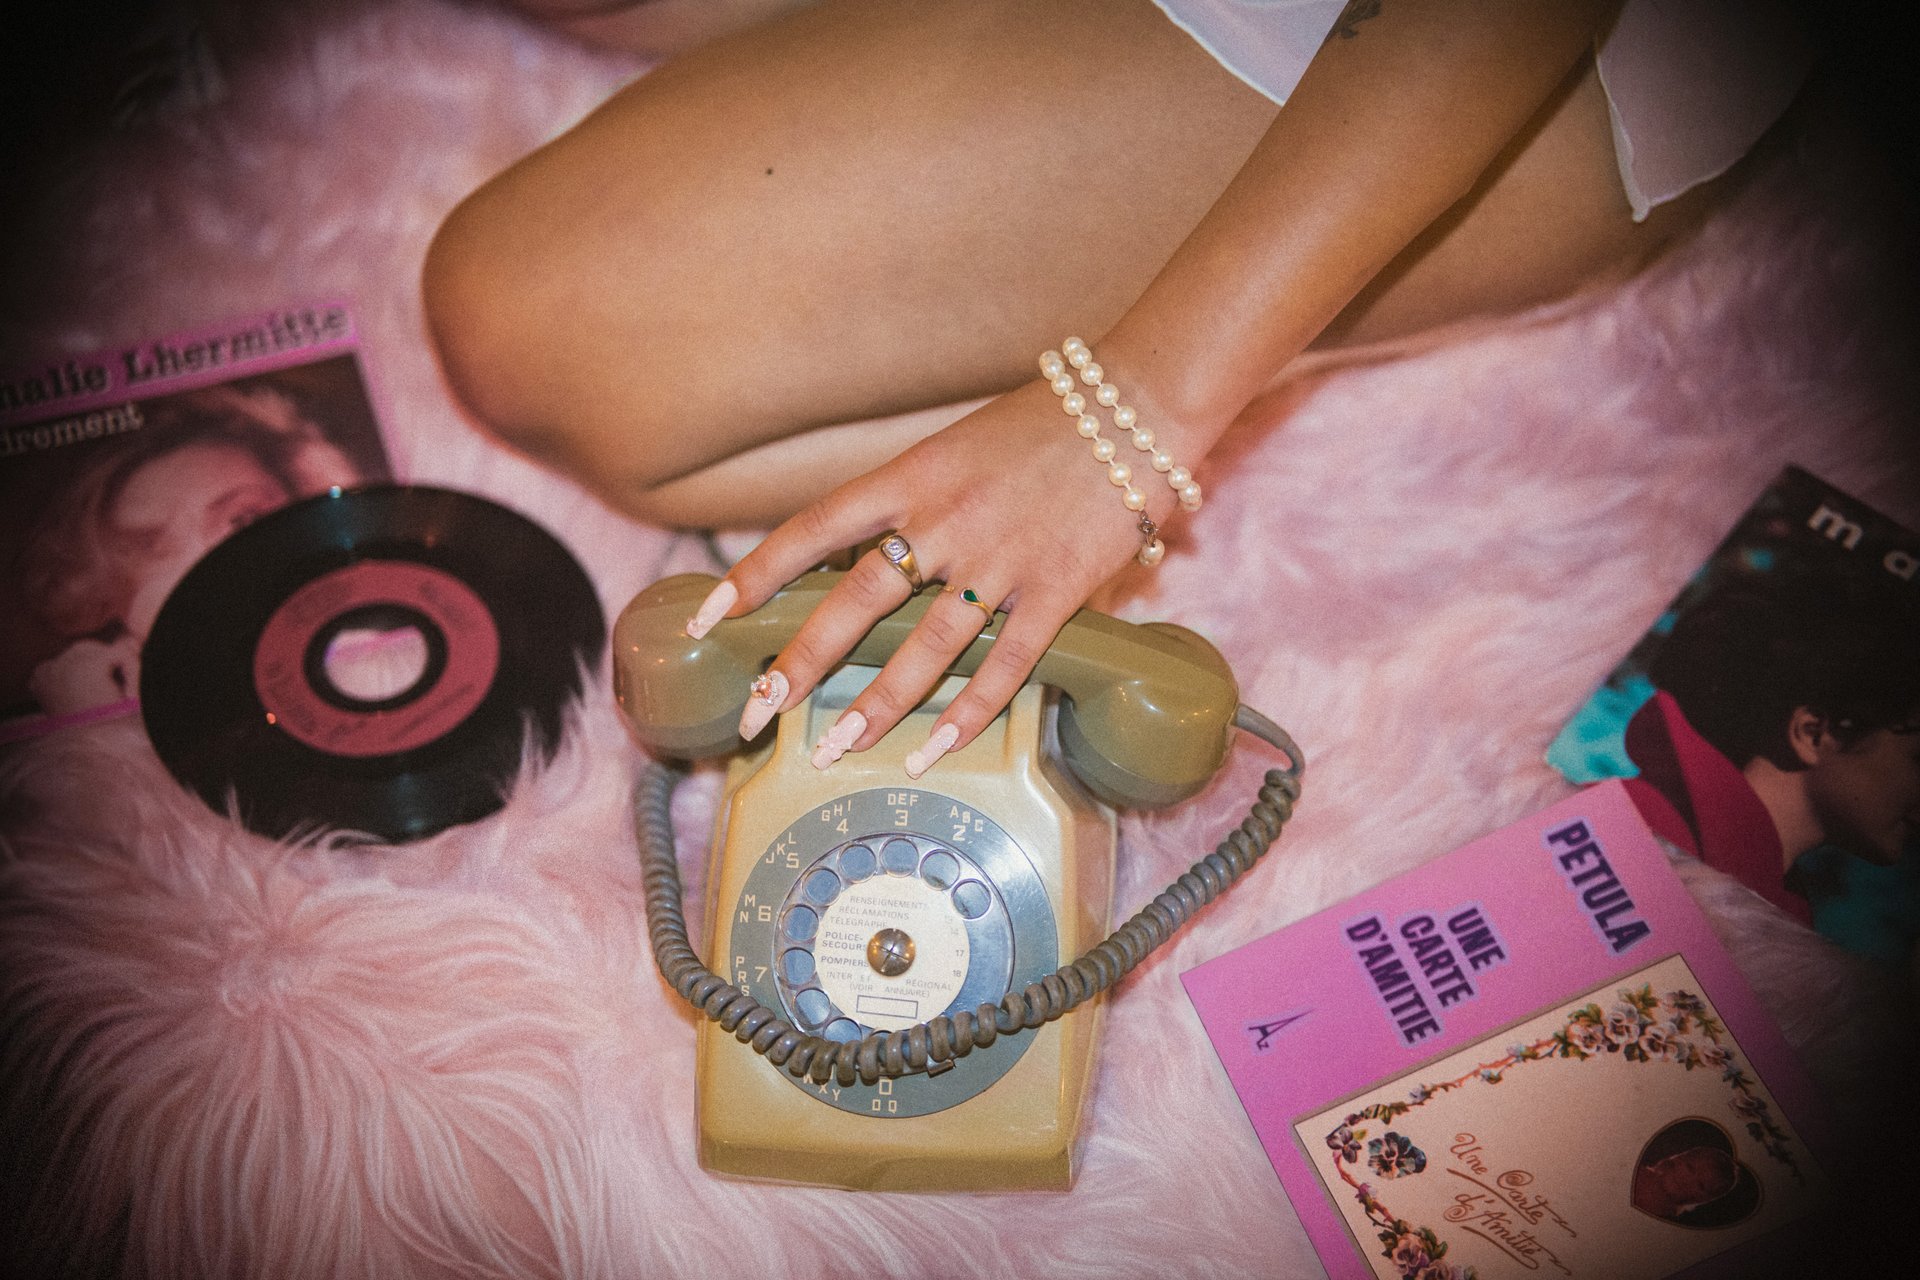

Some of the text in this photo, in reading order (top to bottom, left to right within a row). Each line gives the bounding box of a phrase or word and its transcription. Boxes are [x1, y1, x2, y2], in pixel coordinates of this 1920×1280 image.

[121, 304, 348, 383] Lhermitte
[888, 793, 918, 806] DEF
[822, 800, 851, 821] GHI
[895, 809, 908, 826] 3
[950, 806, 983, 832] ABC
[836, 818, 849, 834] 4
[952, 824, 966, 841] 2
[766, 832, 796, 864] JKL
[786, 853, 799, 869] 5
[1548, 820, 1651, 953] PETULA
[758, 905, 771, 922] 6
[825, 931, 864, 941] POLICE-
[1448, 908, 1505, 970] UNE
[955, 949, 964, 957] 17
[1401, 916, 1474, 1007] CARTE
[754, 966, 767, 982] 7
[1347, 917, 1440, 1043] D'AMITIE
[1450, 1132, 1556, 1228] Une Carte
